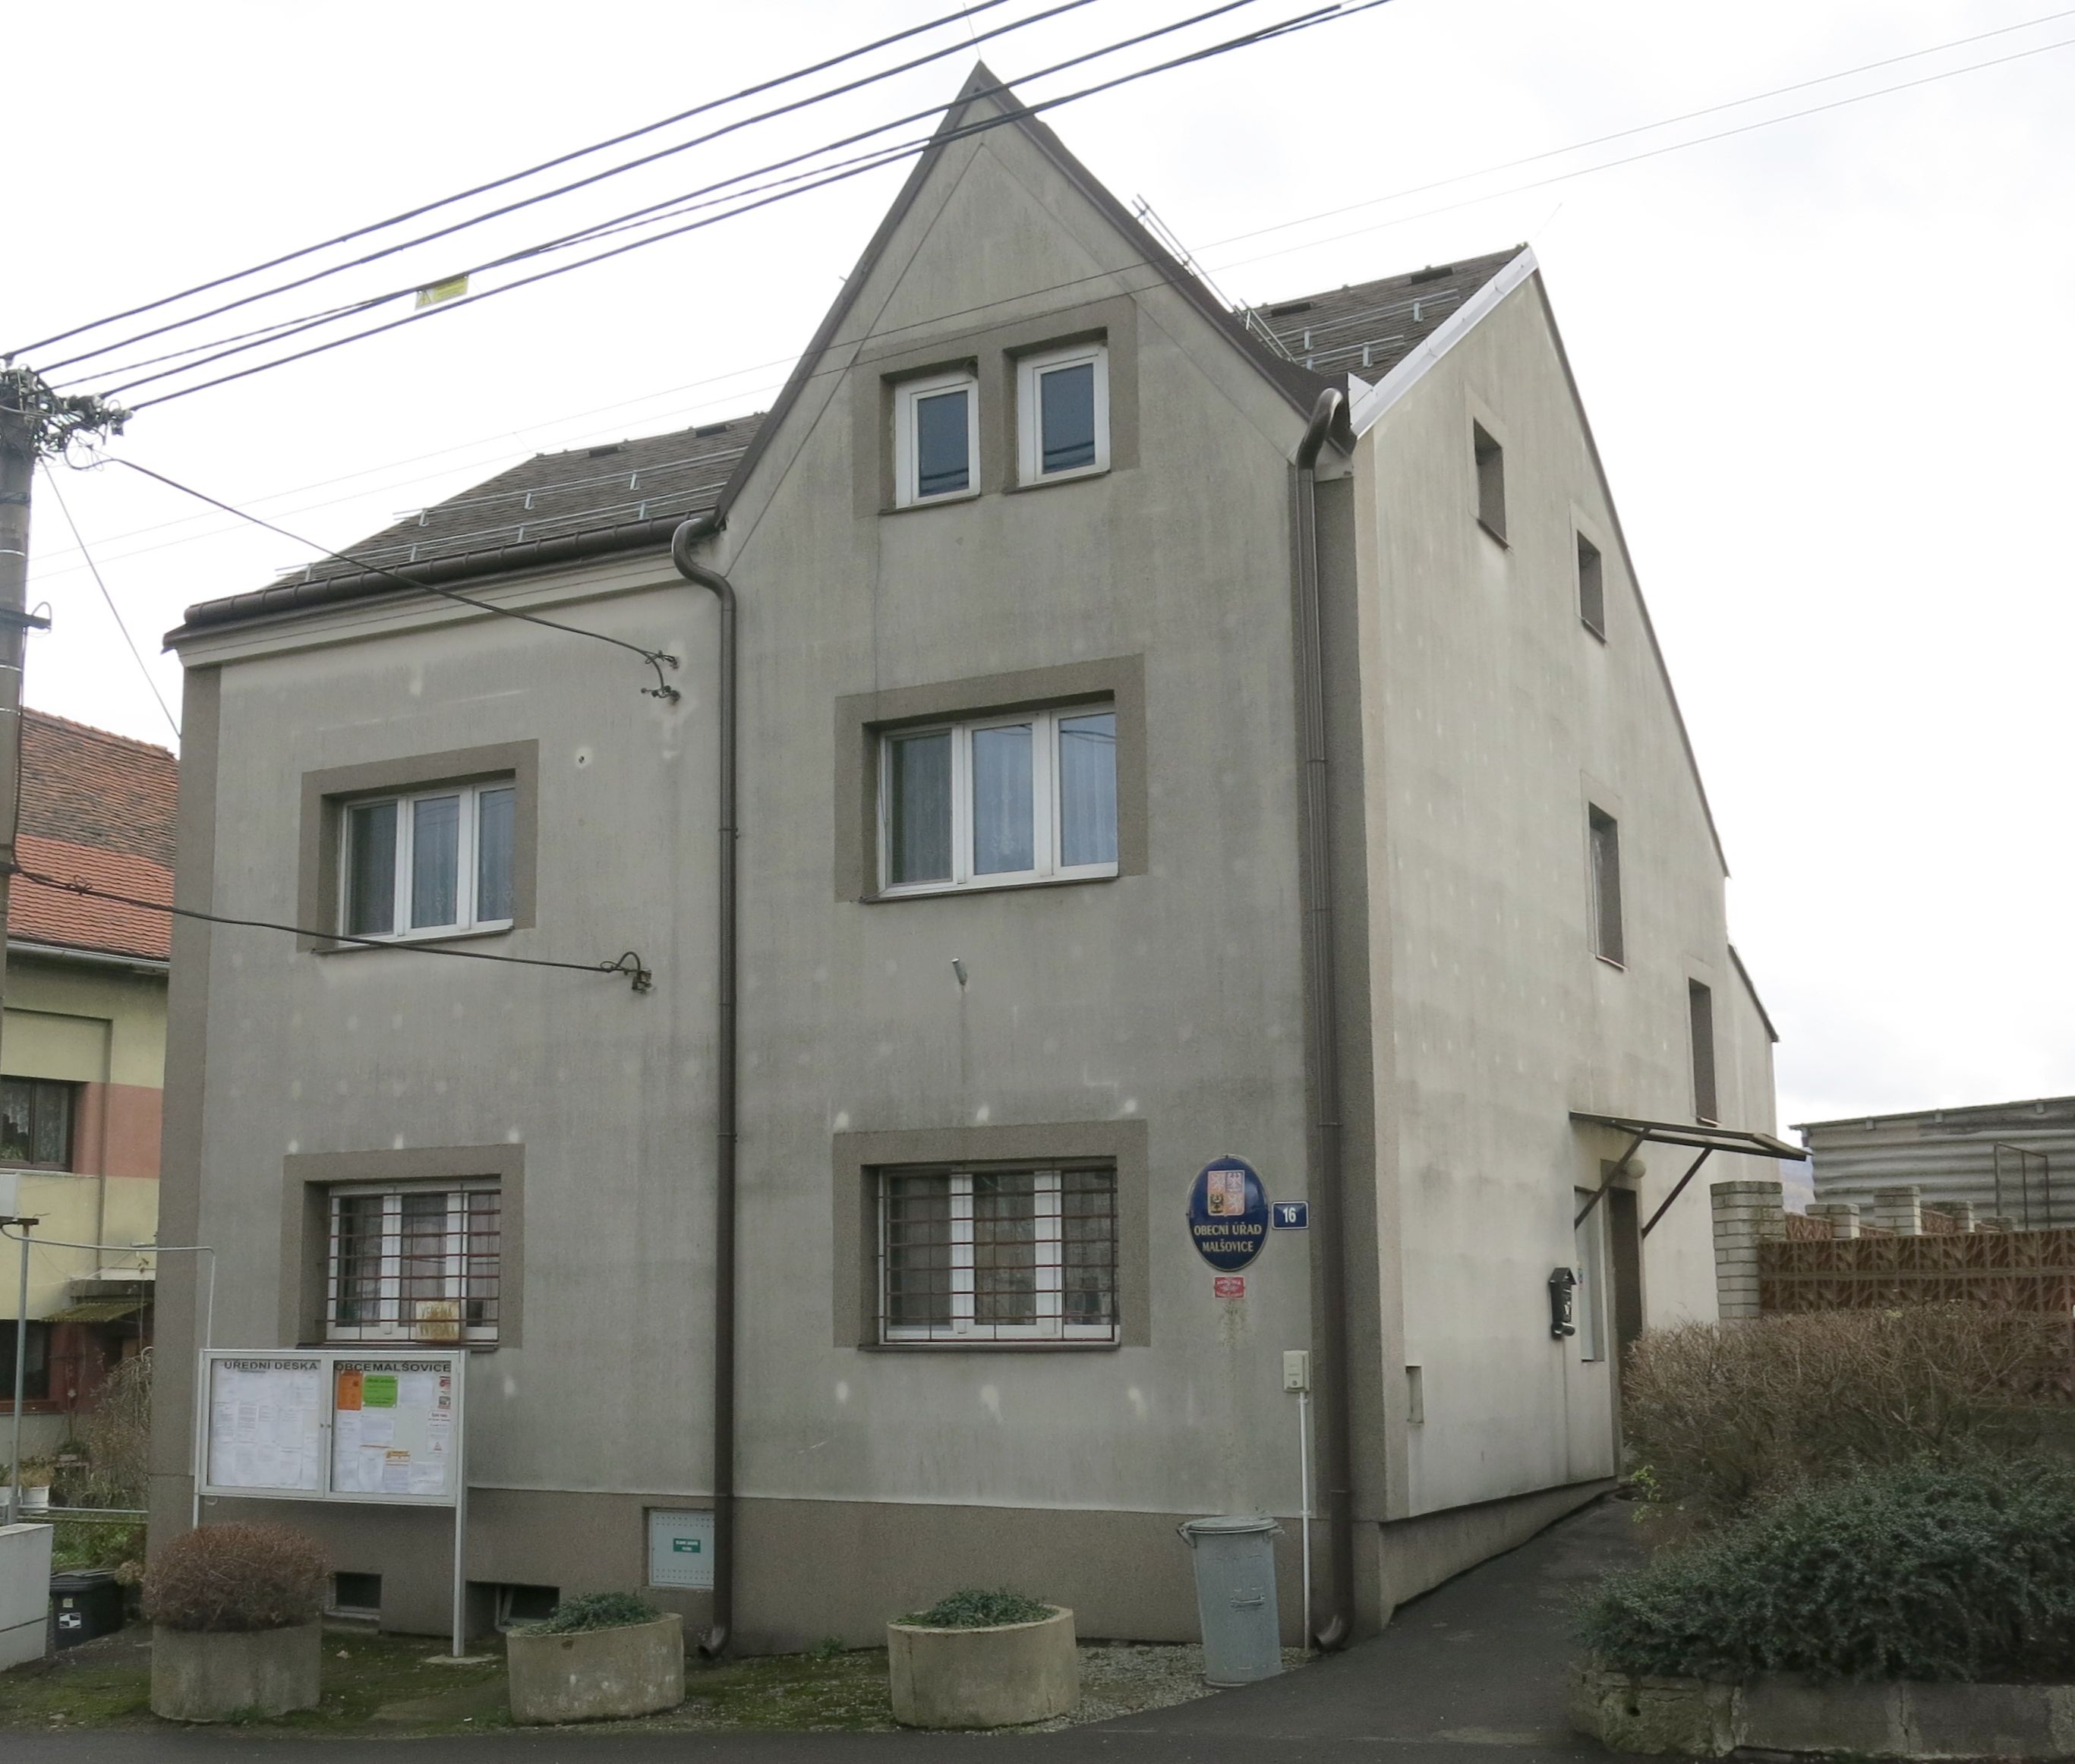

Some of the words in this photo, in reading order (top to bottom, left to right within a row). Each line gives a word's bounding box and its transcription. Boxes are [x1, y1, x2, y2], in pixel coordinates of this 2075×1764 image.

[1282, 1207, 1296, 1223] 16
[1194, 1222, 1228, 1235] OBECNÍ
[1231, 1221, 1262, 1235] ÚŘAD
[1202, 1239, 1254, 1252] MALŠOVICE
[274, 1362, 317, 1370] DESKA
[335, 1362, 371, 1371] OBCE
